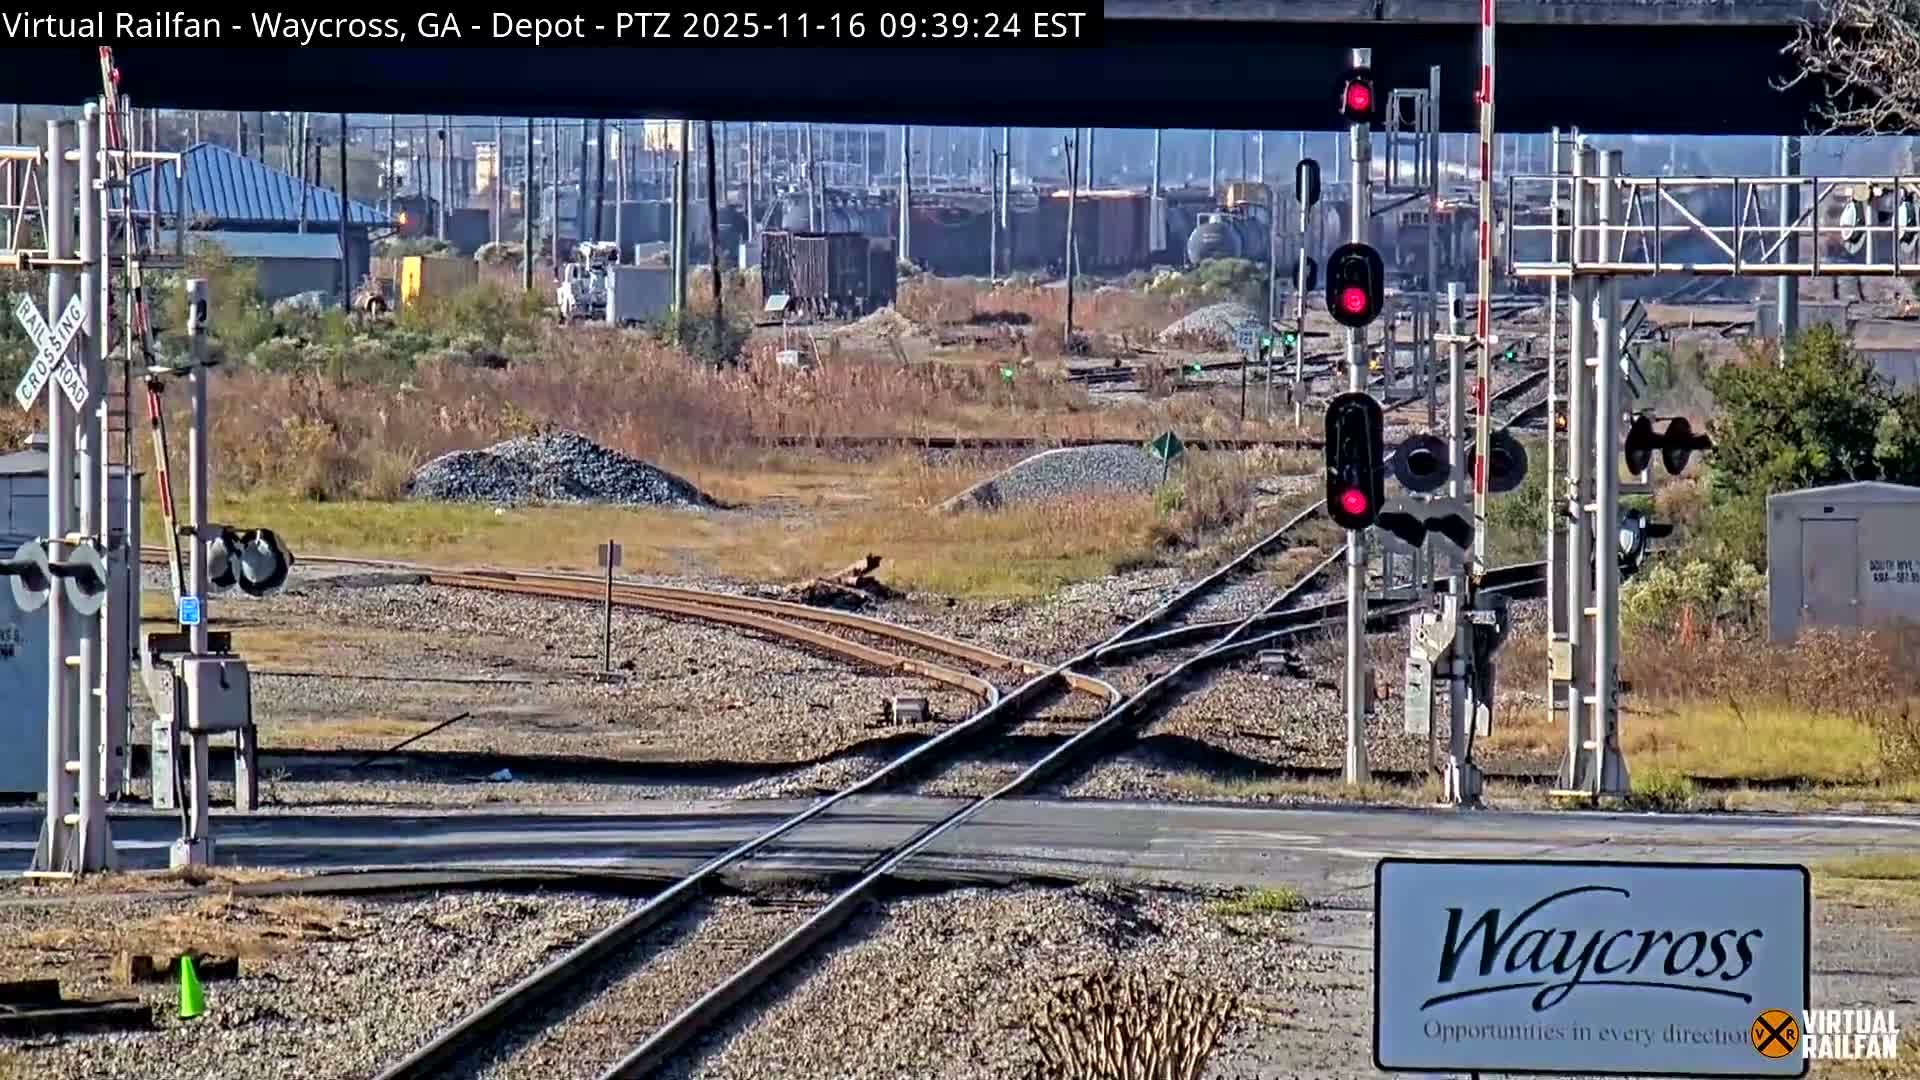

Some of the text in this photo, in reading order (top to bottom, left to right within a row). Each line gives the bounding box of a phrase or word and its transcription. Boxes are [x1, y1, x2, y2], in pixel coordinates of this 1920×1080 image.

[19, 301, 45, 346] RAIL
[21, 304, 81, 400] CROSSING
[1437, 886, 1763, 1012] Waycross
[1423, 1018, 1567, 1048] Opportunities
[1573, 1021, 1592, 1041] in
[1599, 1026, 1656, 1049] every
